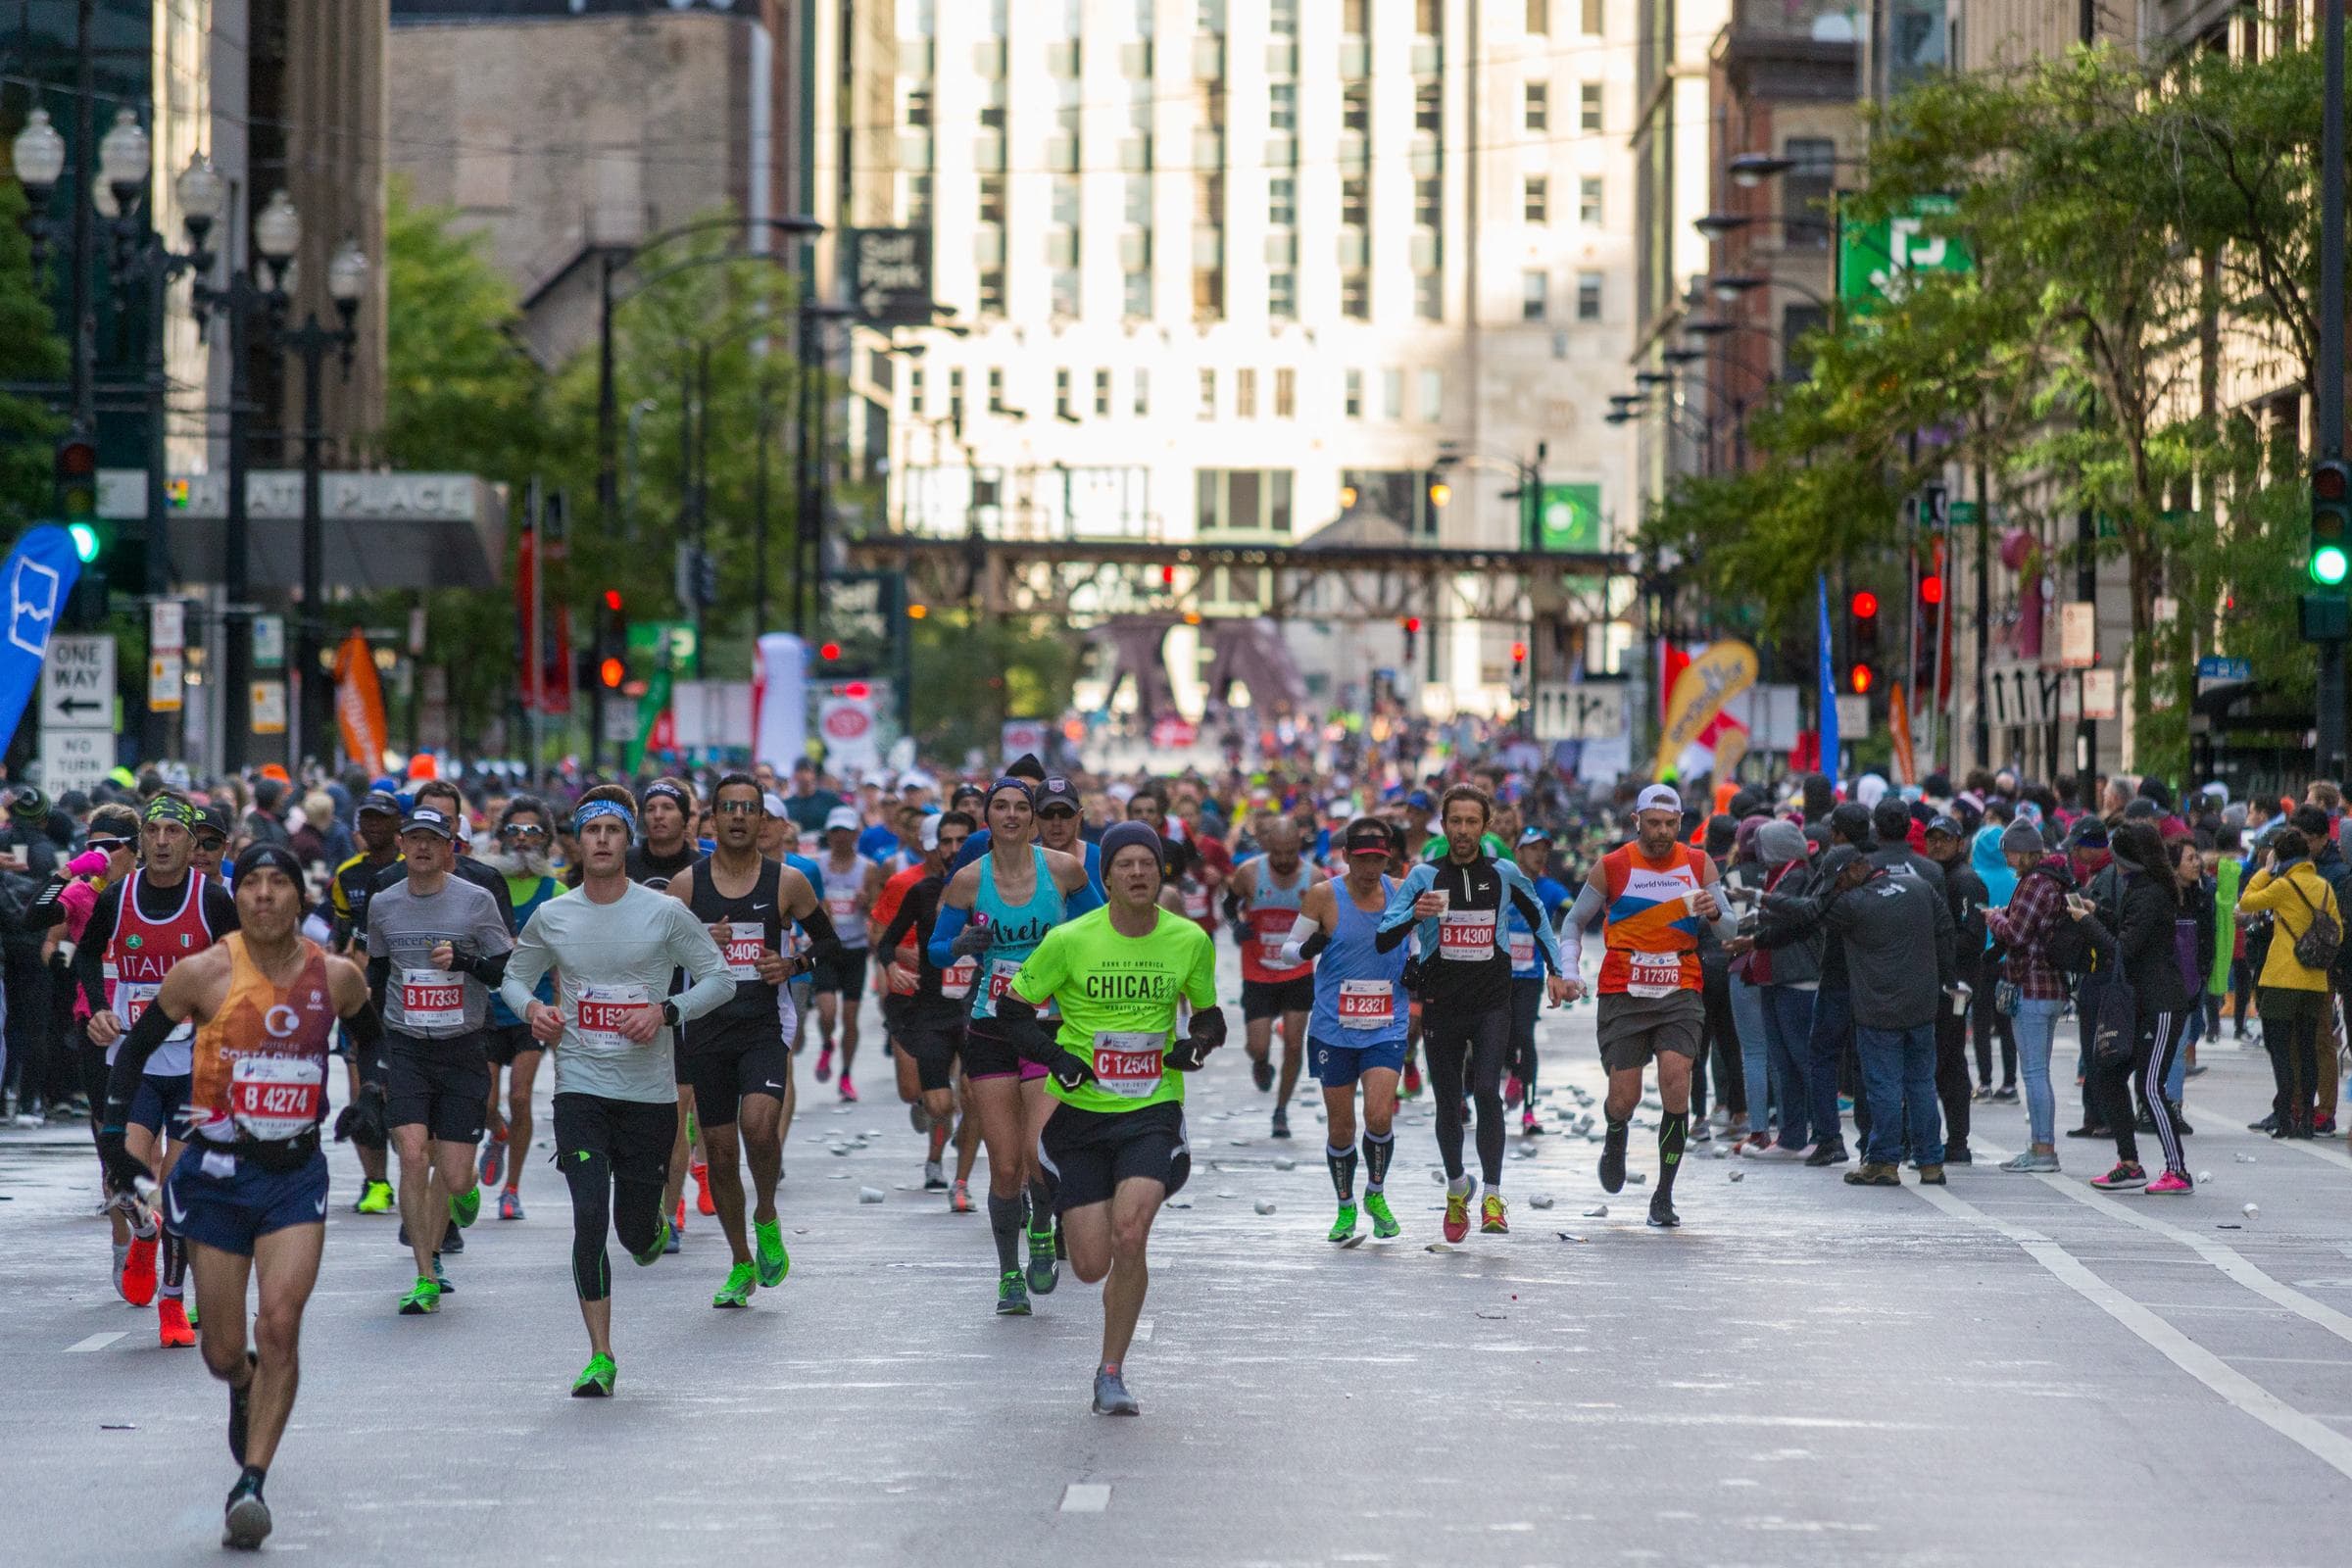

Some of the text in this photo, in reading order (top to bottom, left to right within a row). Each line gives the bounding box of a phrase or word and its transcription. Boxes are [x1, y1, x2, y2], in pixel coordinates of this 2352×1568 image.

[56, 643, 102, 664] ONE
[54, 670, 101, 688] WAY
[65, 740, 91, 754] NO
[59, 759, 102, 771] TURN
[1634, 878, 1680, 890] World Vision
[1443, 927, 1493, 944] B 14300
[725, 943, 760, 960] 3406
[123, 956, 176, 977] ITAL
[1632, 967, 1679, 983] B 17376
[946, 969, 956, 983] D
[994, 979, 1003, 997] C
[407, 988, 460, 1007] B 17333
[1346, 997, 1386, 1013] B 2321
[130, 1004, 142, 1024] B
[582, 1005, 592, 1025] C
[1099, 1053, 1157, 1075] C 12541
[245, 1085, 309, 1113] B 4274
